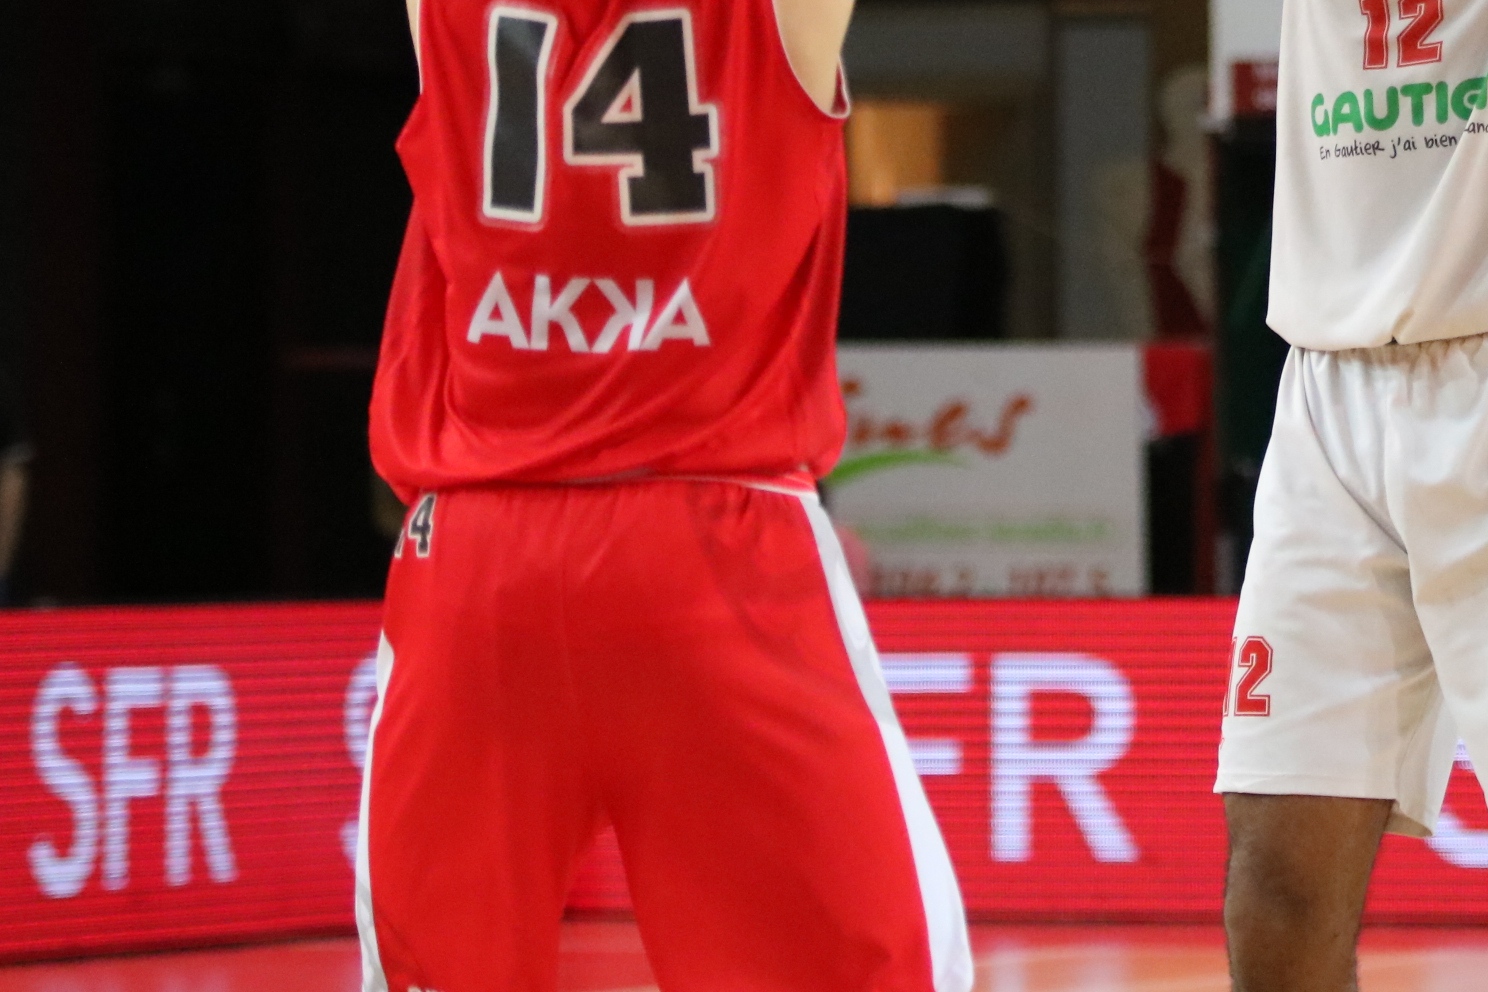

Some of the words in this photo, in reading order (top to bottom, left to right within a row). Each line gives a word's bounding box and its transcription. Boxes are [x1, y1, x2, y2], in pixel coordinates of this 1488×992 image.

[482, 4, 720, 228] 14
[1319, 146, 1331, 161] En
[1390, 137, 1417, 159] j'ai
[1424, 134, 1458, 149] bien
[466, 272, 711, 355] AKKA
[394, 492, 437, 558] 4
[27, 661, 239, 898] SFR
